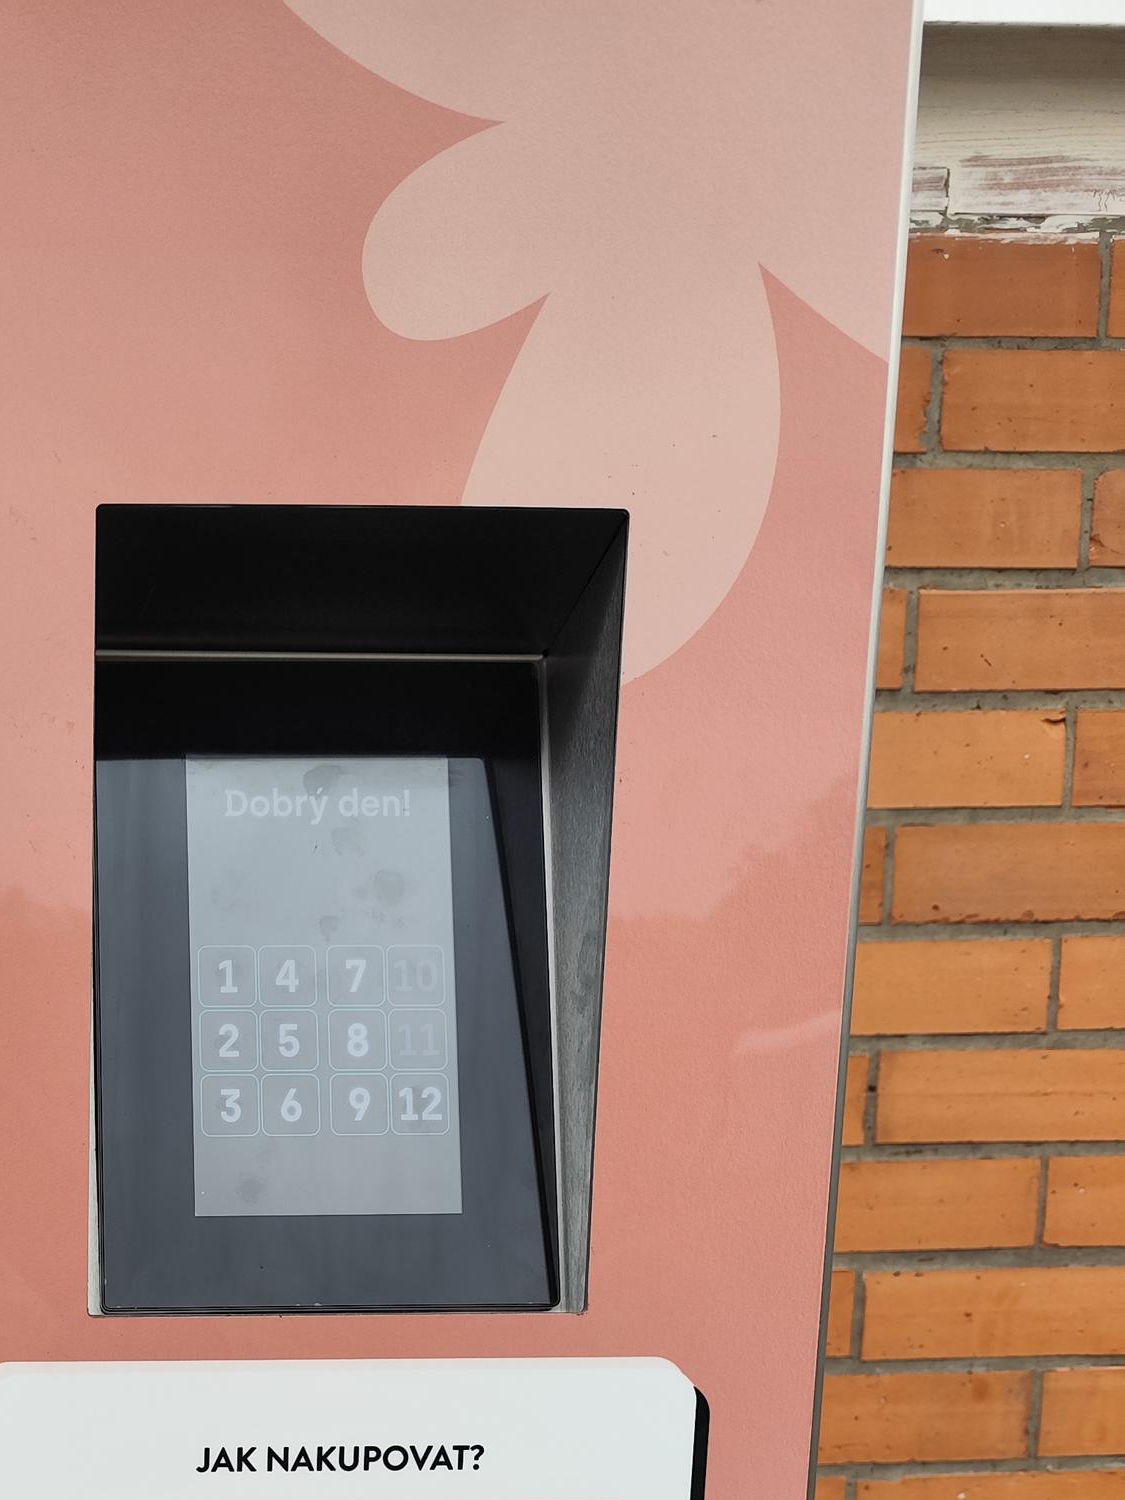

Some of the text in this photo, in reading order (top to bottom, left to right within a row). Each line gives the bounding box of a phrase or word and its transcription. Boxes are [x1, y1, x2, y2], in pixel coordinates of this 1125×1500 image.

[225, 788, 411, 825] Dobrý den!
[218, 959, 239, 994] 1
[275, 960, 300, 993] 4
[344, 959, 367, 993] 7
[393, 959, 438, 992] 10
[218, 1024, 240, 1058] 2
[278, 1024, 300, 1057] 5
[346, 1023, 369, 1057] 8
[399, 1023, 440, 1056] 11
[220, 1088, 242, 1123] 3
[280, 1088, 302, 1122] 6
[348, 1087, 371, 1121] 9
[398, 1087, 442, 1121] 12
[196, 1444, 485, 1473] JAK NAKUPOVAT?
